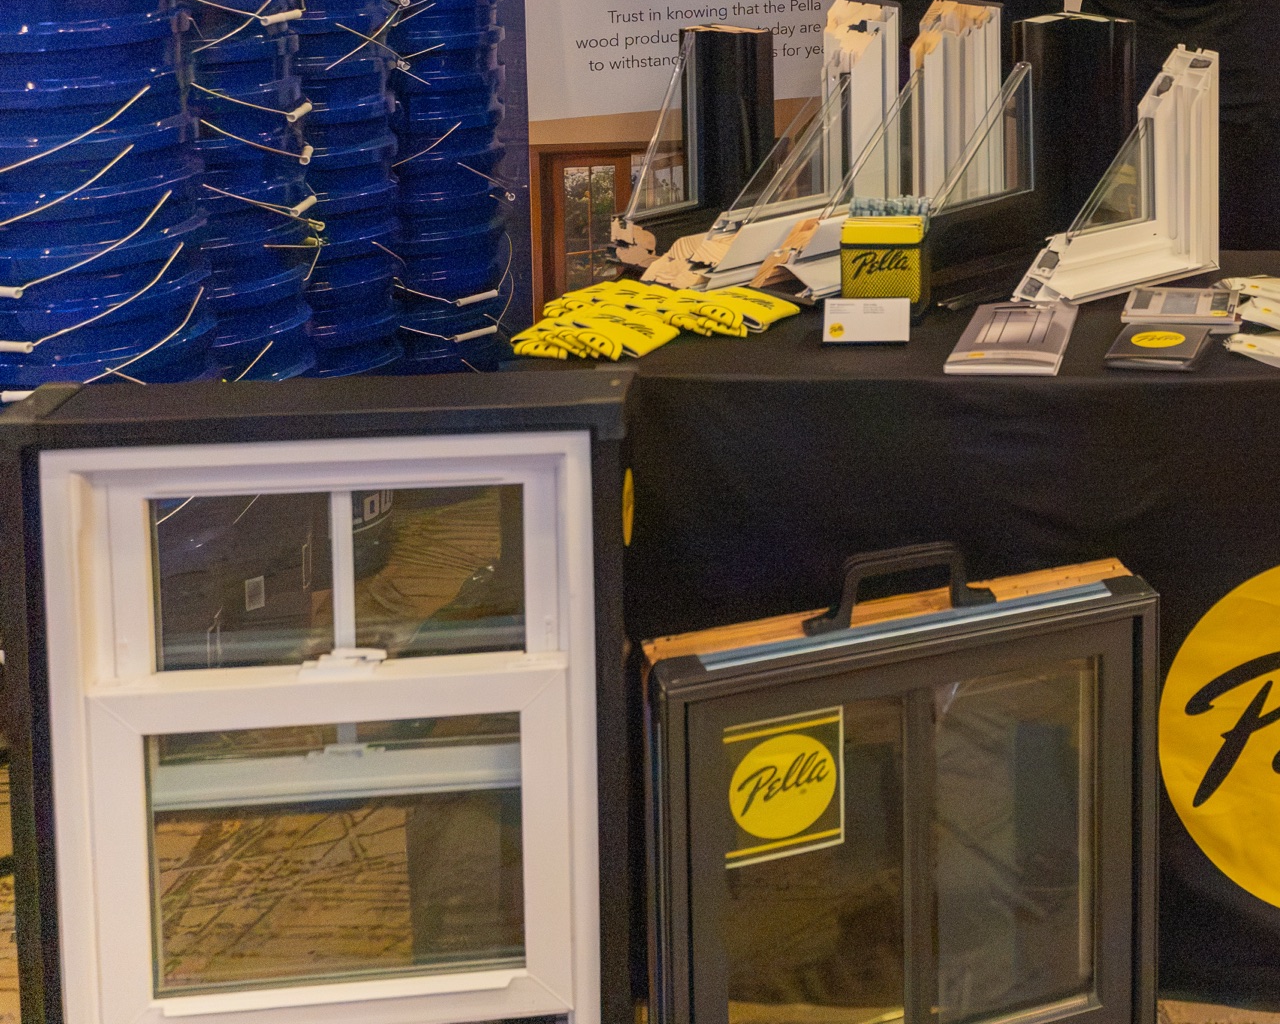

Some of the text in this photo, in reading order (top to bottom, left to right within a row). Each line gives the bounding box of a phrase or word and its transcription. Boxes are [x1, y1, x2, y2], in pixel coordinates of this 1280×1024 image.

[607, 9, 644, 24] Trust
[648, 7, 662, 22] in
[666, 5, 728, 22] knowing
[732, 2, 760, 16] that
[763, 0, 786, 14] the
[799, 23, 822, 34] are
[576, 29, 678, 50] wood produc
[782, 42, 802, 57] for
[589, 59, 604, 72] to
[851, 248, 909, 280] Pella
[737, 751, 835, 817] Pella
